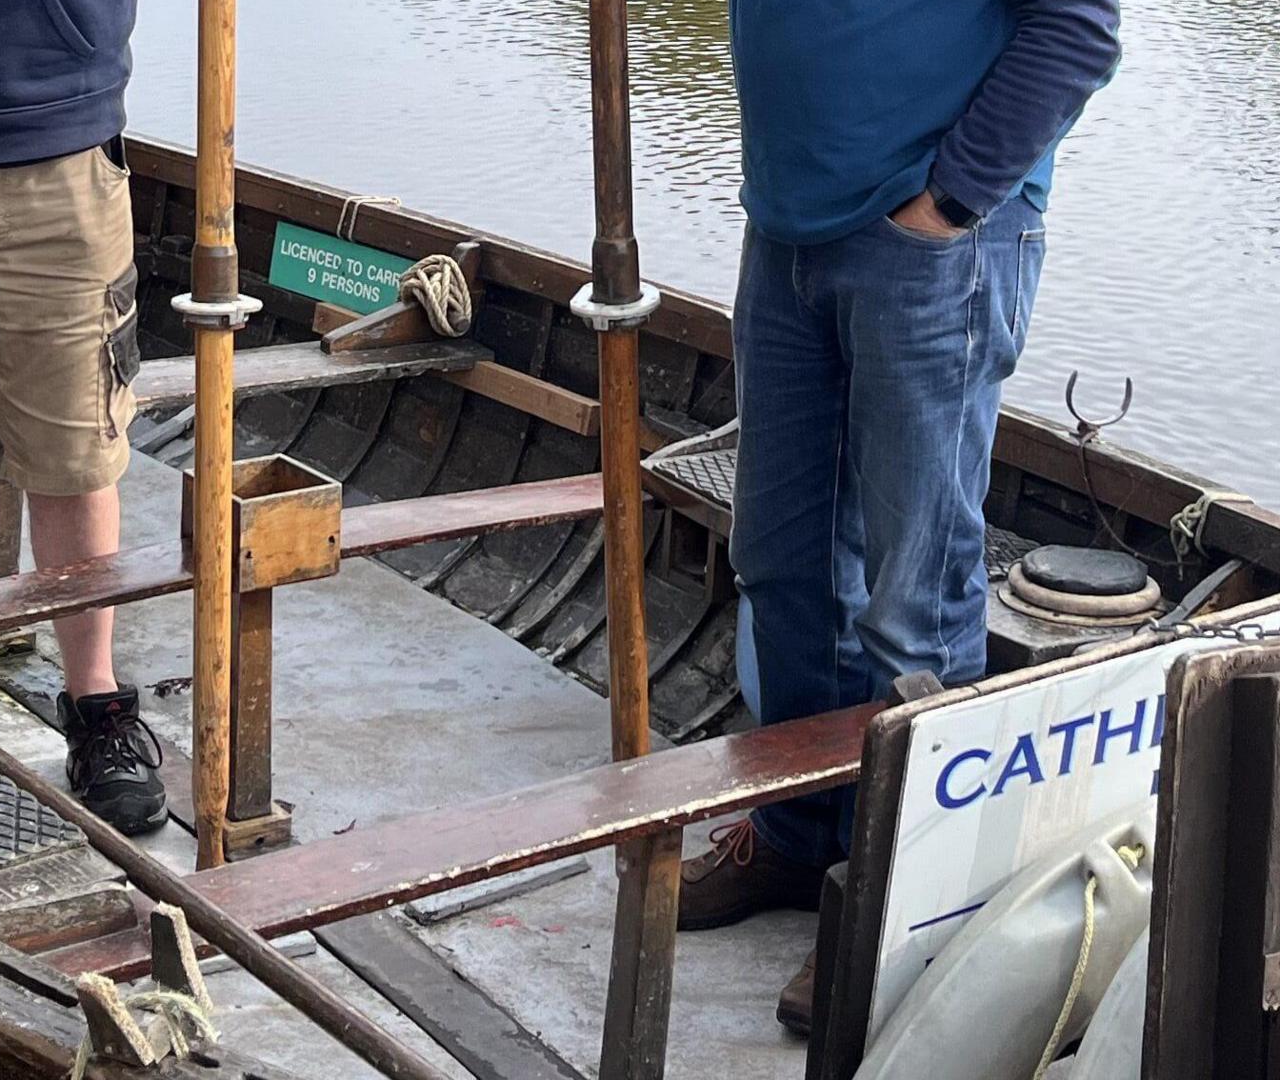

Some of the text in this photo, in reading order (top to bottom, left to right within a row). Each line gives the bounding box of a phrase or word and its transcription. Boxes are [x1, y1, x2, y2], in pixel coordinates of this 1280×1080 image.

[280, 239, 401, 289] LICENCED TO CARR
[307, 267, 381, 302] 9 PERSONS
[935, 694, 1166, 810] CATH
